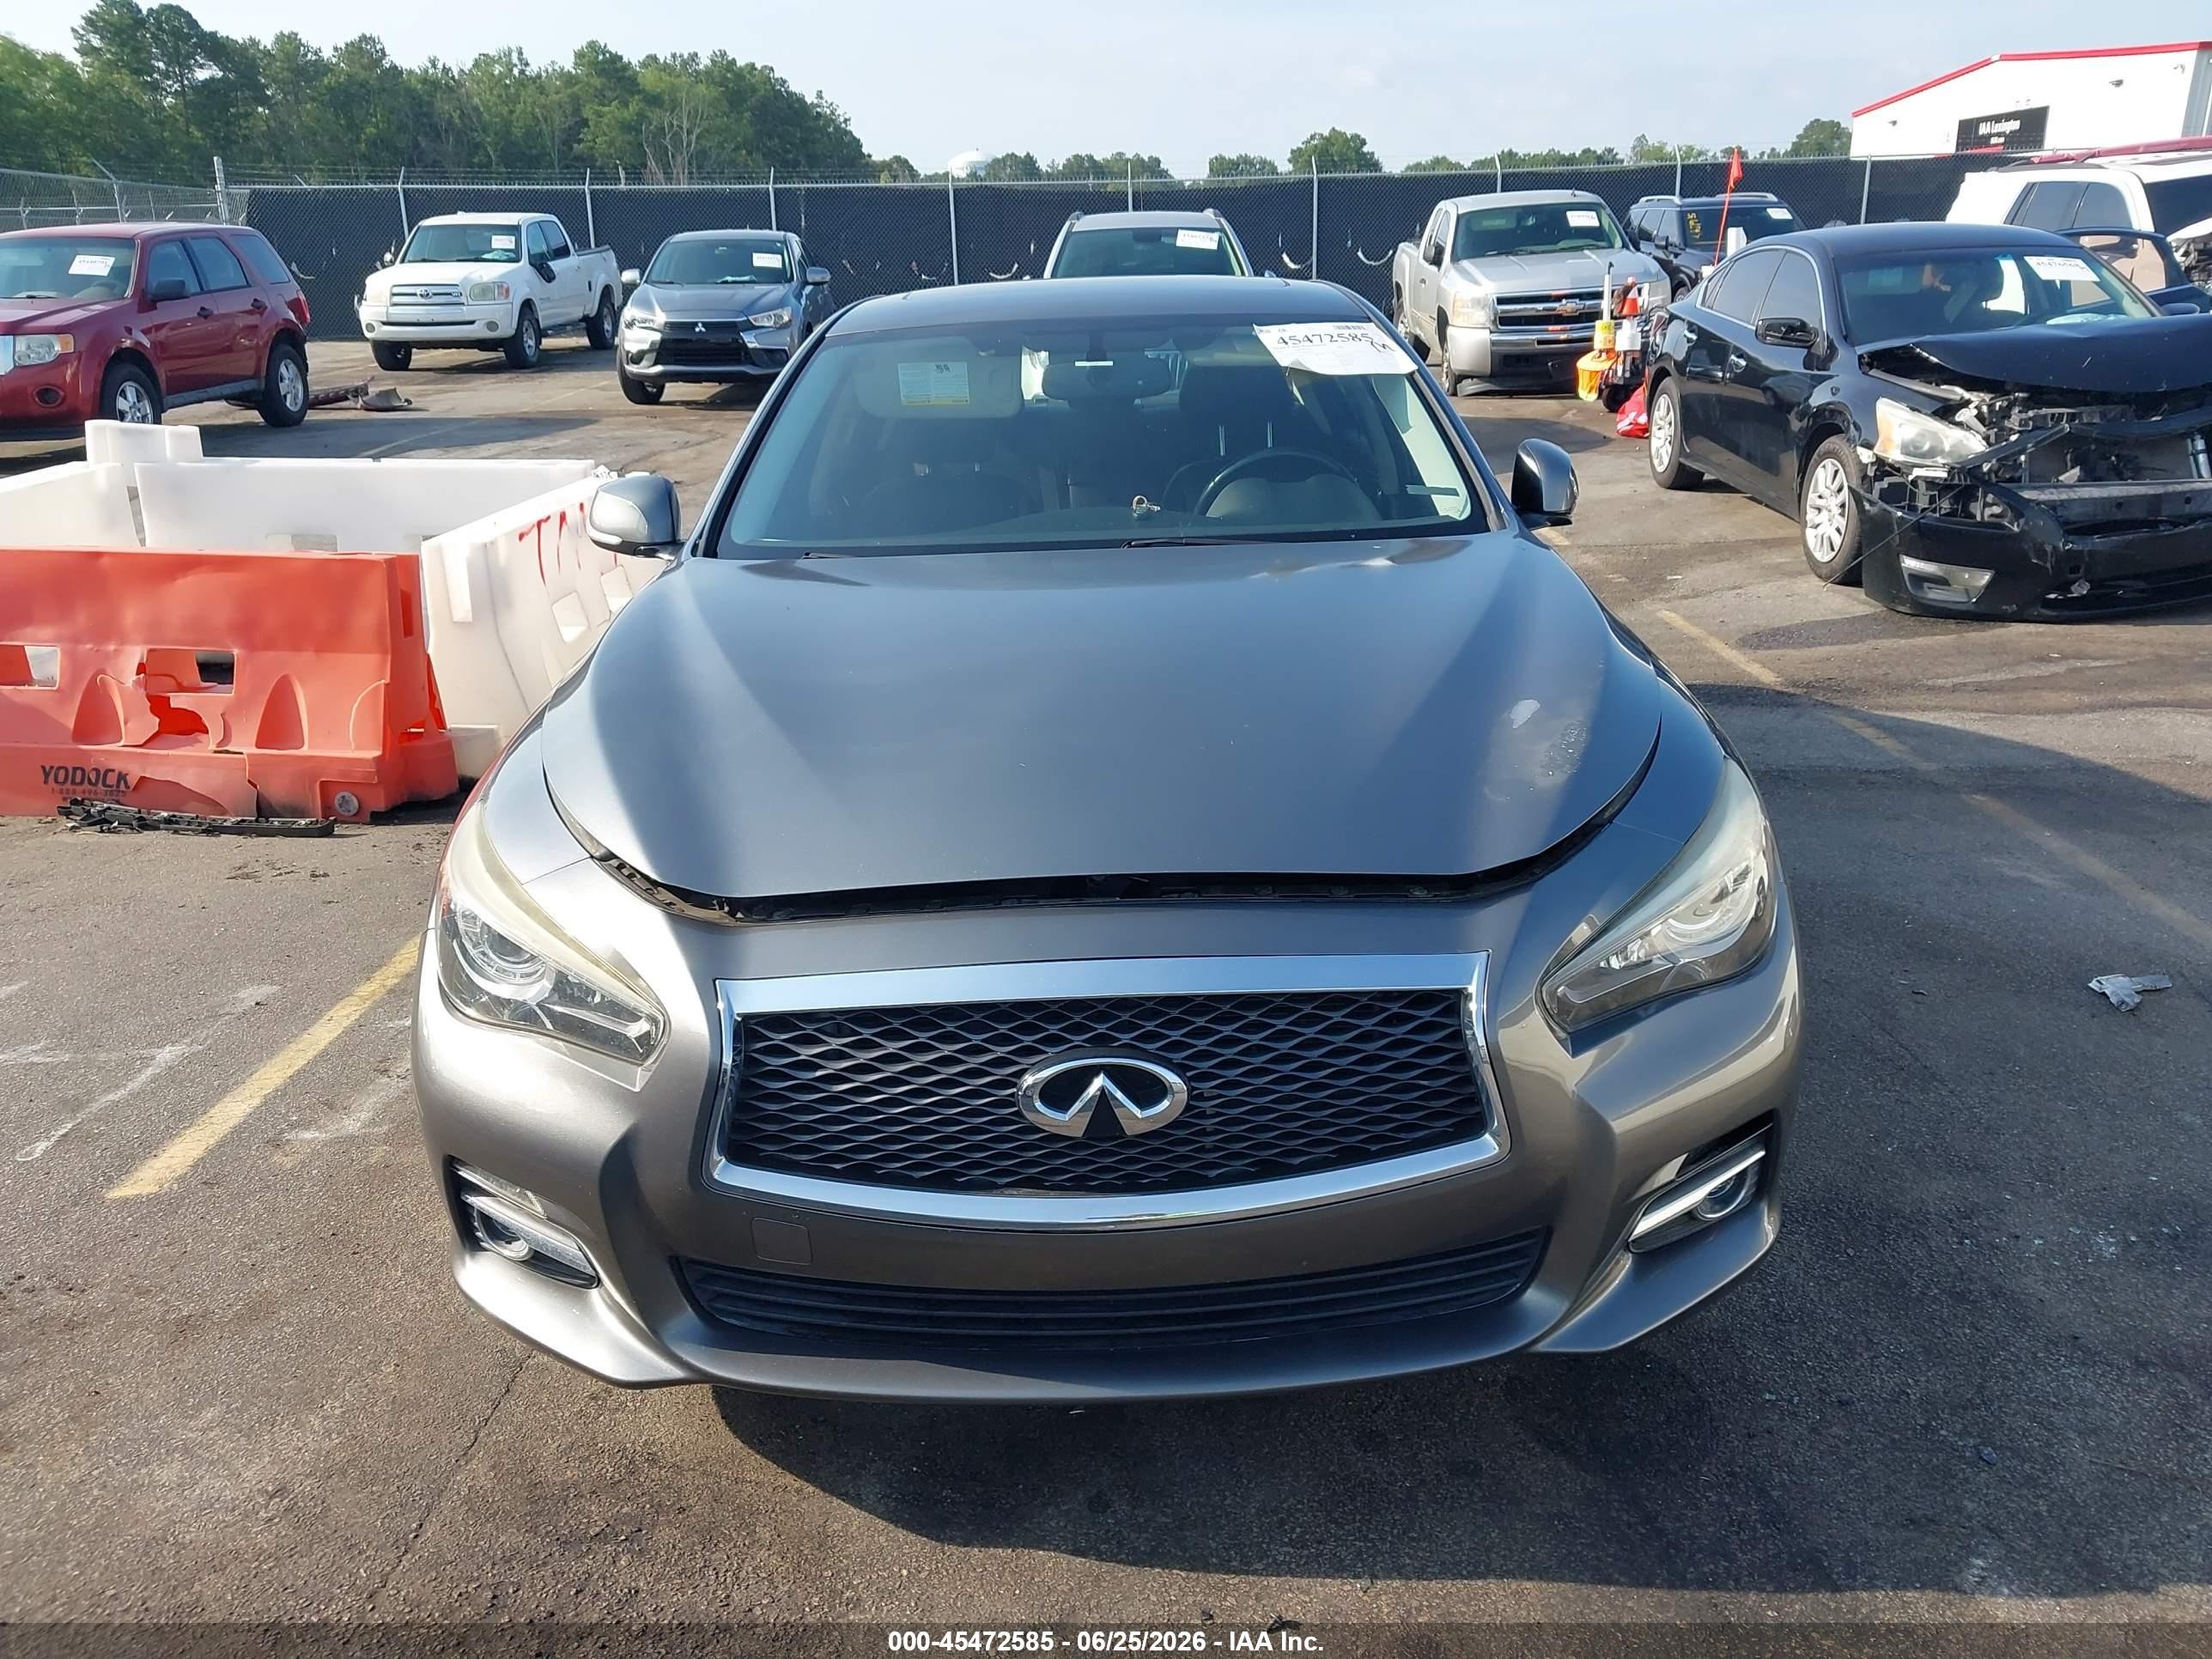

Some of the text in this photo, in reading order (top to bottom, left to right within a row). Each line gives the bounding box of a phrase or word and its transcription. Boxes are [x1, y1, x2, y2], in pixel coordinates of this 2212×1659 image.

[1978, 118, 2021, 135] IAA Lexington
[1278, 332, 1374, 345] 45472585
[40, 765, 130, 789] YODOCK
